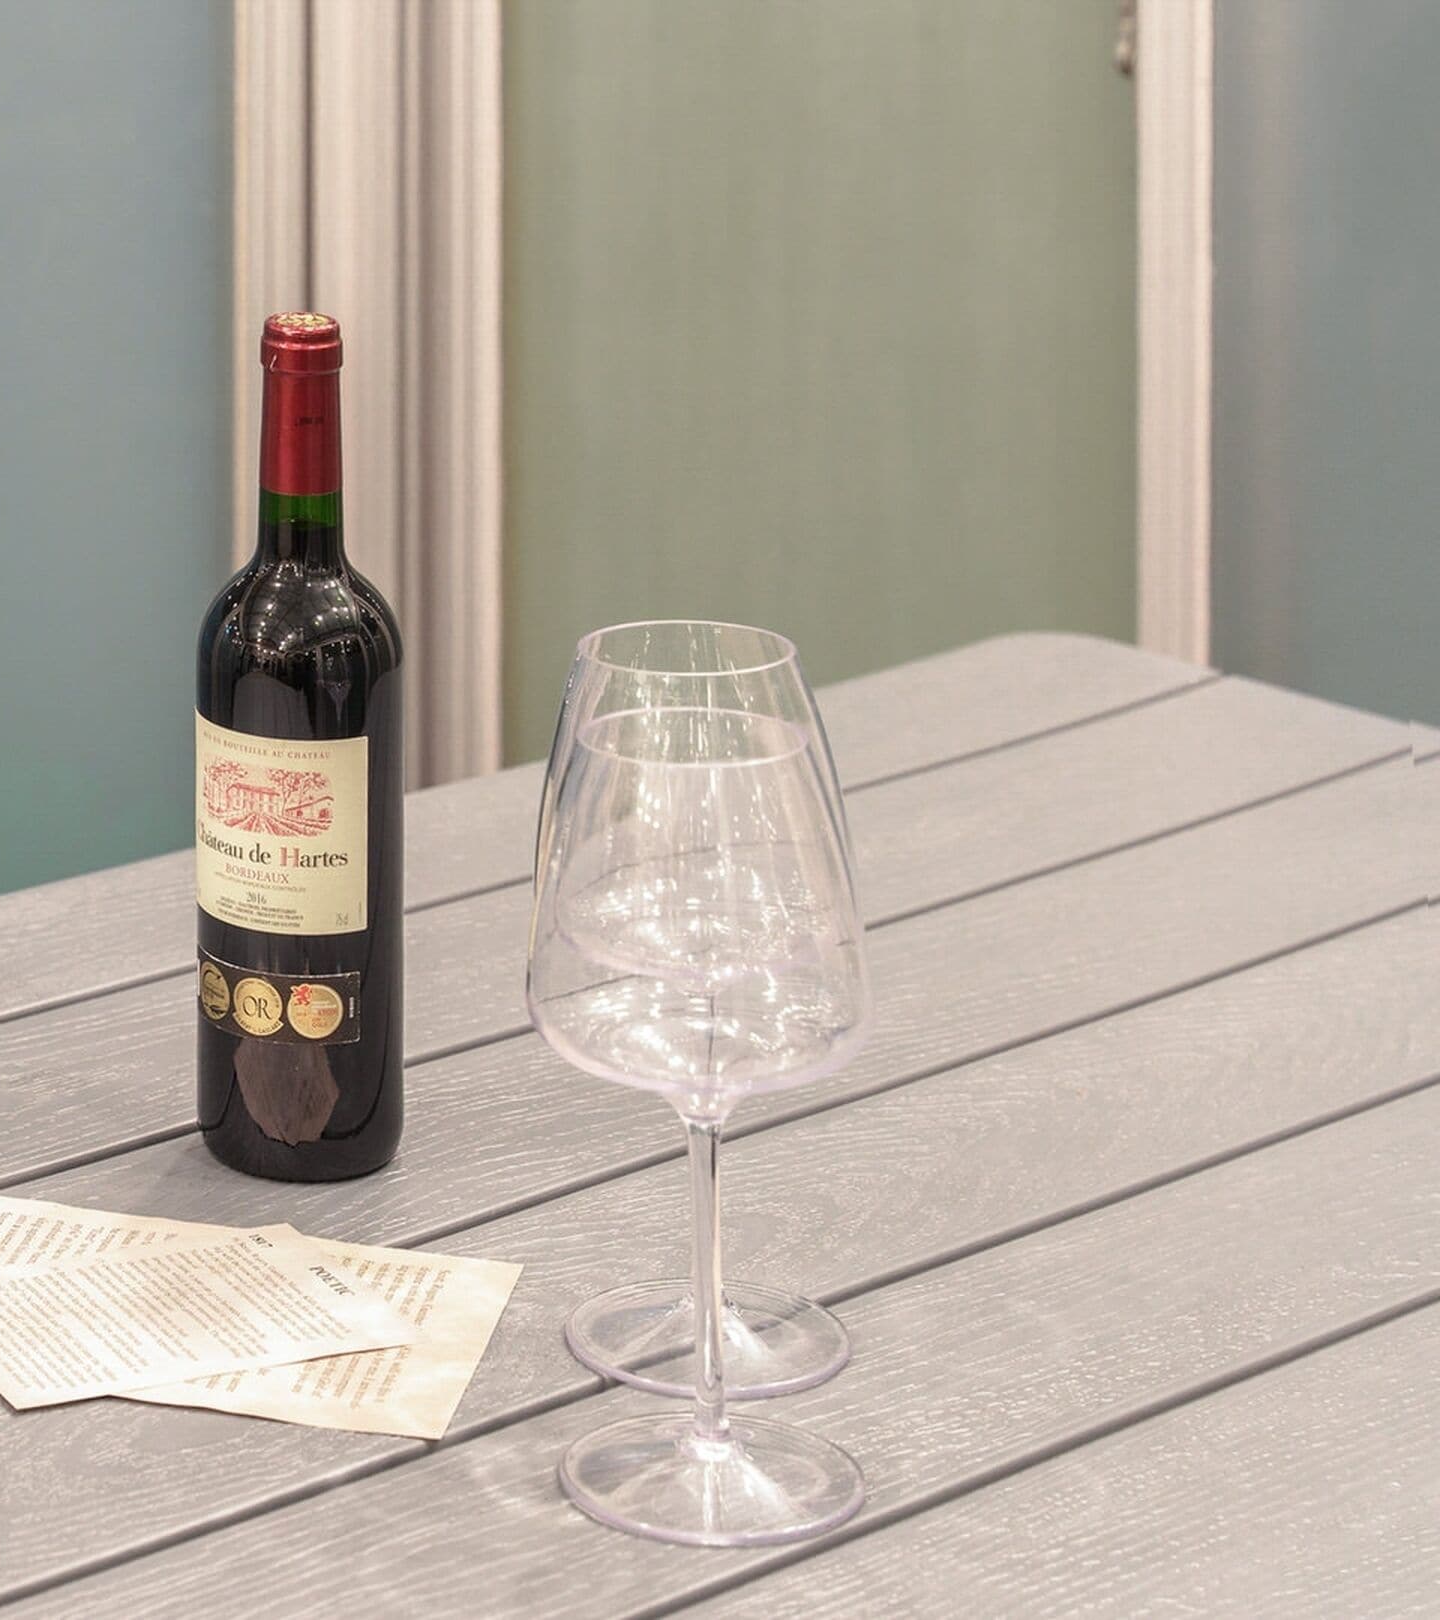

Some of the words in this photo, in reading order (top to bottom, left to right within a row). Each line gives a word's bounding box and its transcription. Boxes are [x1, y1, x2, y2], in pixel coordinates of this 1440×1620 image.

[248, 843, 272, 865] de
[279, 847, 349, 868] Hartes
[224, 862, 290, 884] BORDEAUX
[242, 995, 272, 1020] OR
